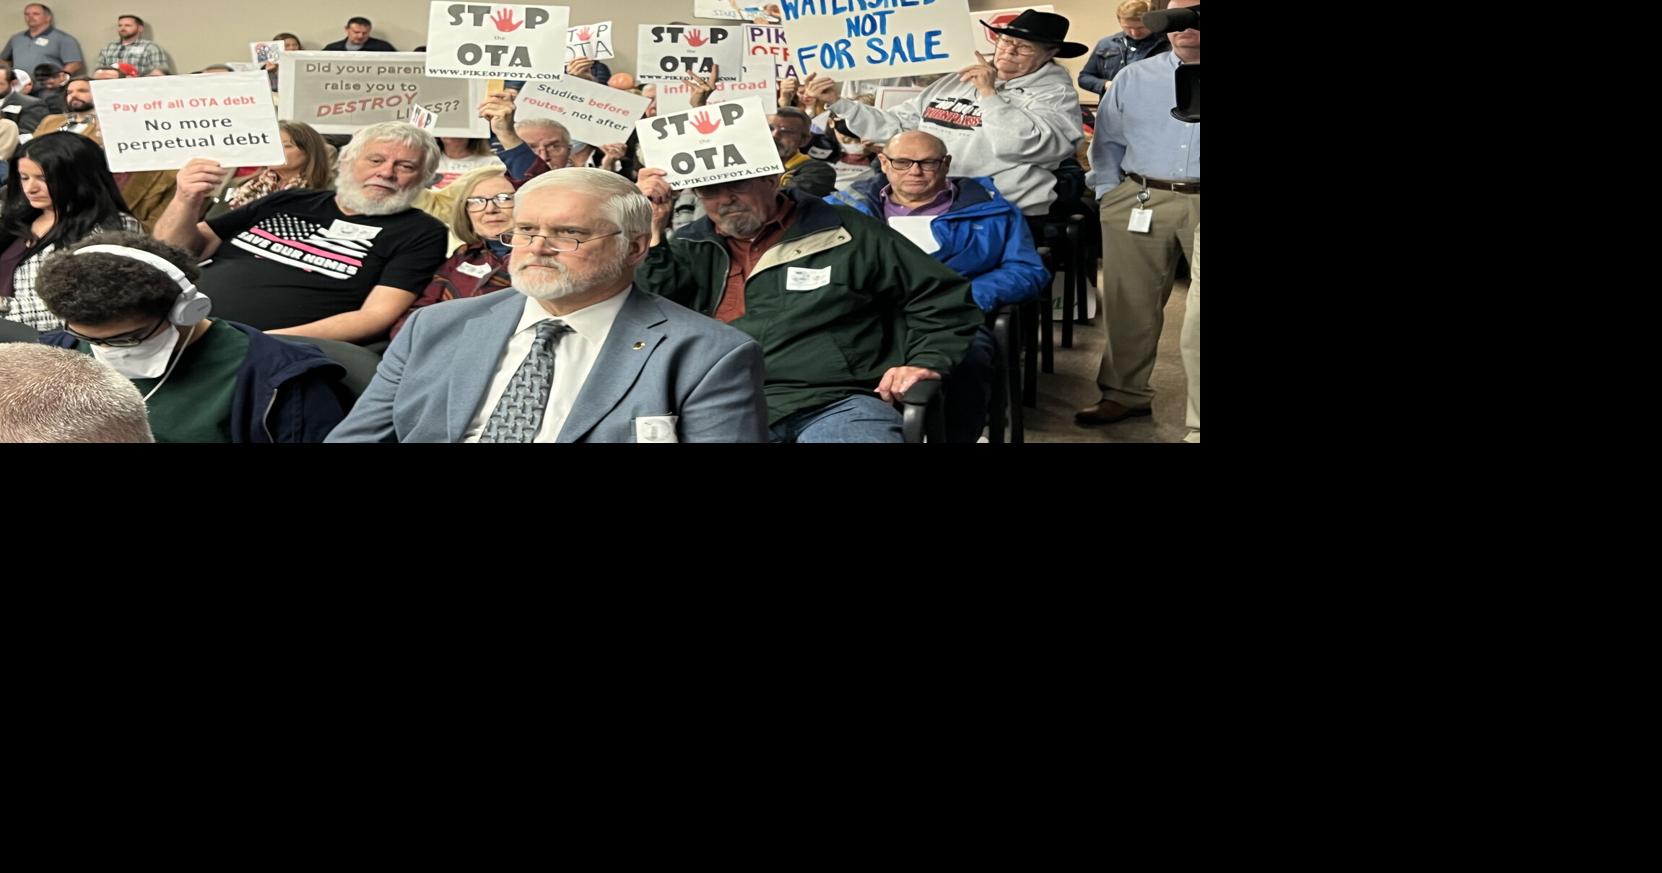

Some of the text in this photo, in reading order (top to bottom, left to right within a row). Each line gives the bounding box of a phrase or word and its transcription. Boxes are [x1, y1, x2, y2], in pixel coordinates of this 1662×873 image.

[448, 4, 549, 32] STP
[780, 0, 936, 21] WATERS
[846, 10, 895, 37] NOT
[651, 27, 728, 47] STP
[457, 43, 532, 68] OTA
[798, 30, 949, 75] FOR SALE
[306, 63, 331, 73] Did
[336, 65, 372, 75] your
[429, 68, 561, 80] WWW.PIKEOFFOTA.COM
[660, 56, 715, 73] OTA
[325, 80, 417, 93] raise you to
[731, 80, 767, 91] road
[112, 95, 256, 112] Pay off all OTA debt
[316, 92, 418, 117] DESTROY
[396, 100, 460, 120] LIES??
[537, 84, 630, 116] Studies before
[145, 117, 233, 131] No more
[523, 96, 628, 131] routes, not after
[651, 103, 744, 140] STP
[117, 132, 270, 154] perpetual debt
[671, 144, 747, 175] OTA
[671, 164, 780, 187] W.PIKEOFFOTA.COM
[236, 231, 358, 275] SAVE OUR HOMES
